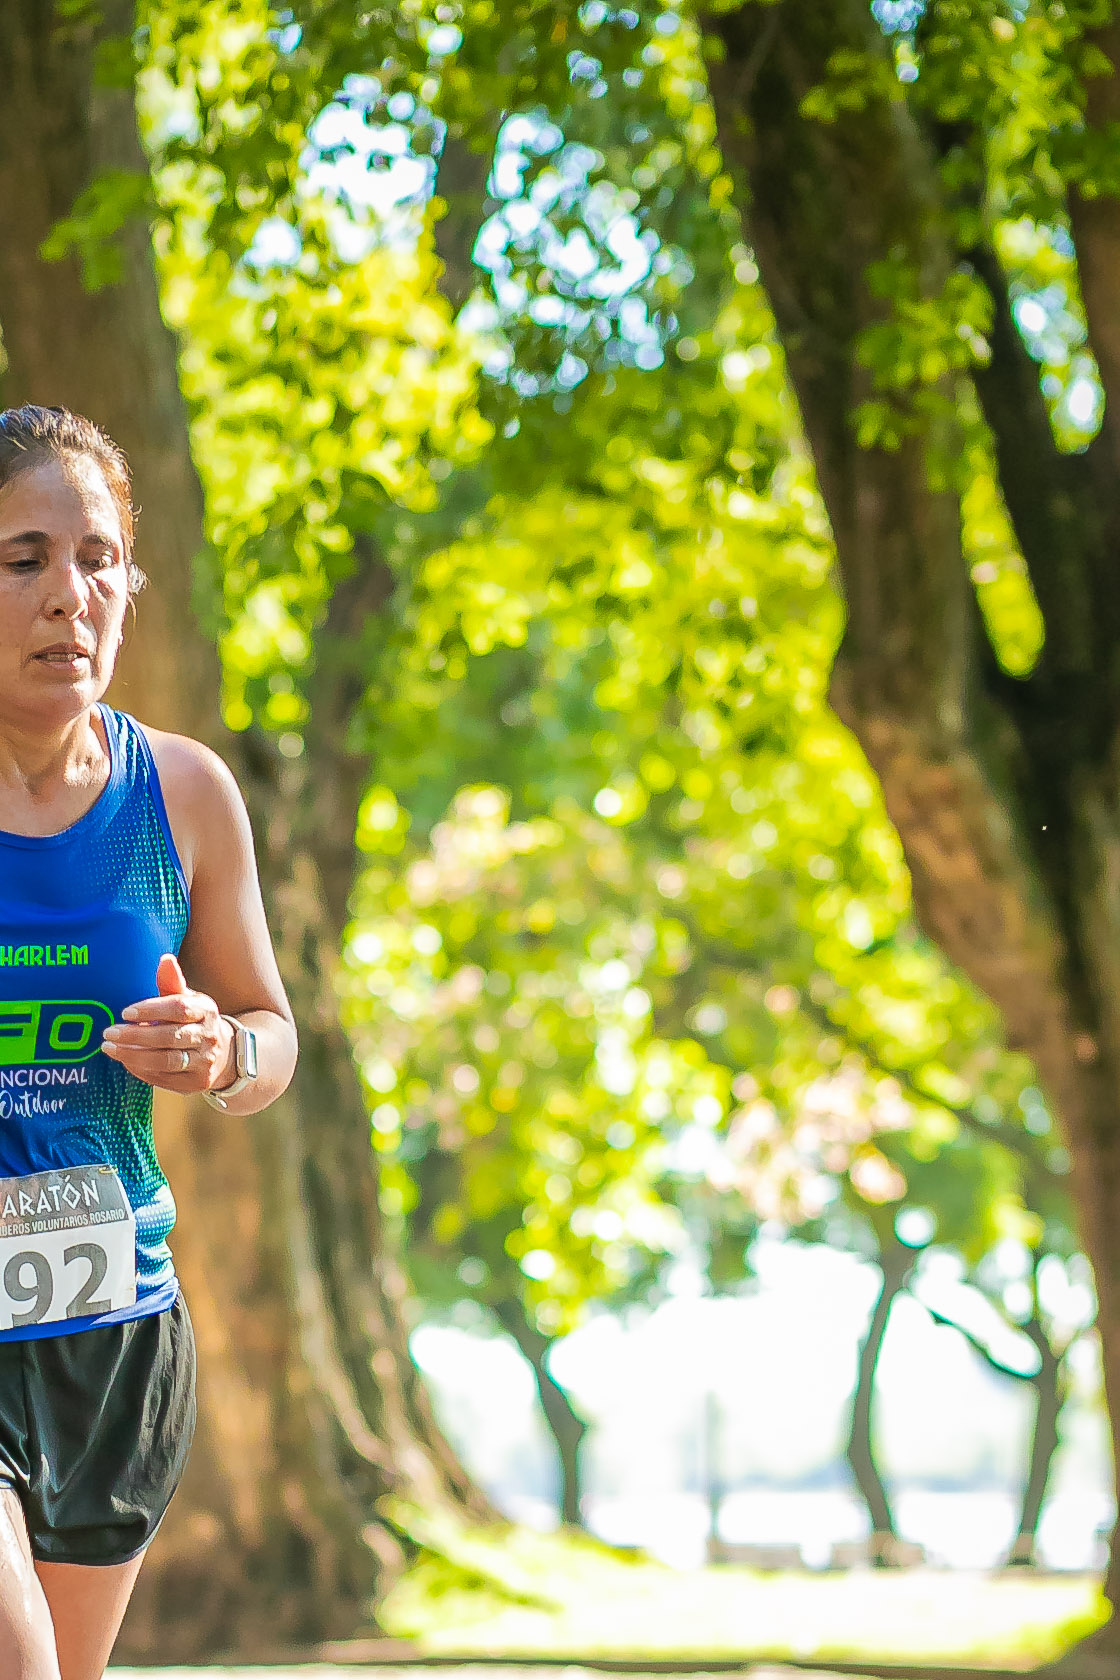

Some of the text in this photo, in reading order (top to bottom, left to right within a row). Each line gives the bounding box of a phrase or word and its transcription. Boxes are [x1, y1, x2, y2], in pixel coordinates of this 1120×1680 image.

[0, 944, 89, 968] HARLEM
[32, 1215, 89, 1232] VOLUNTARIOS
[89, 1208, 126, 1224] ROSARIO
